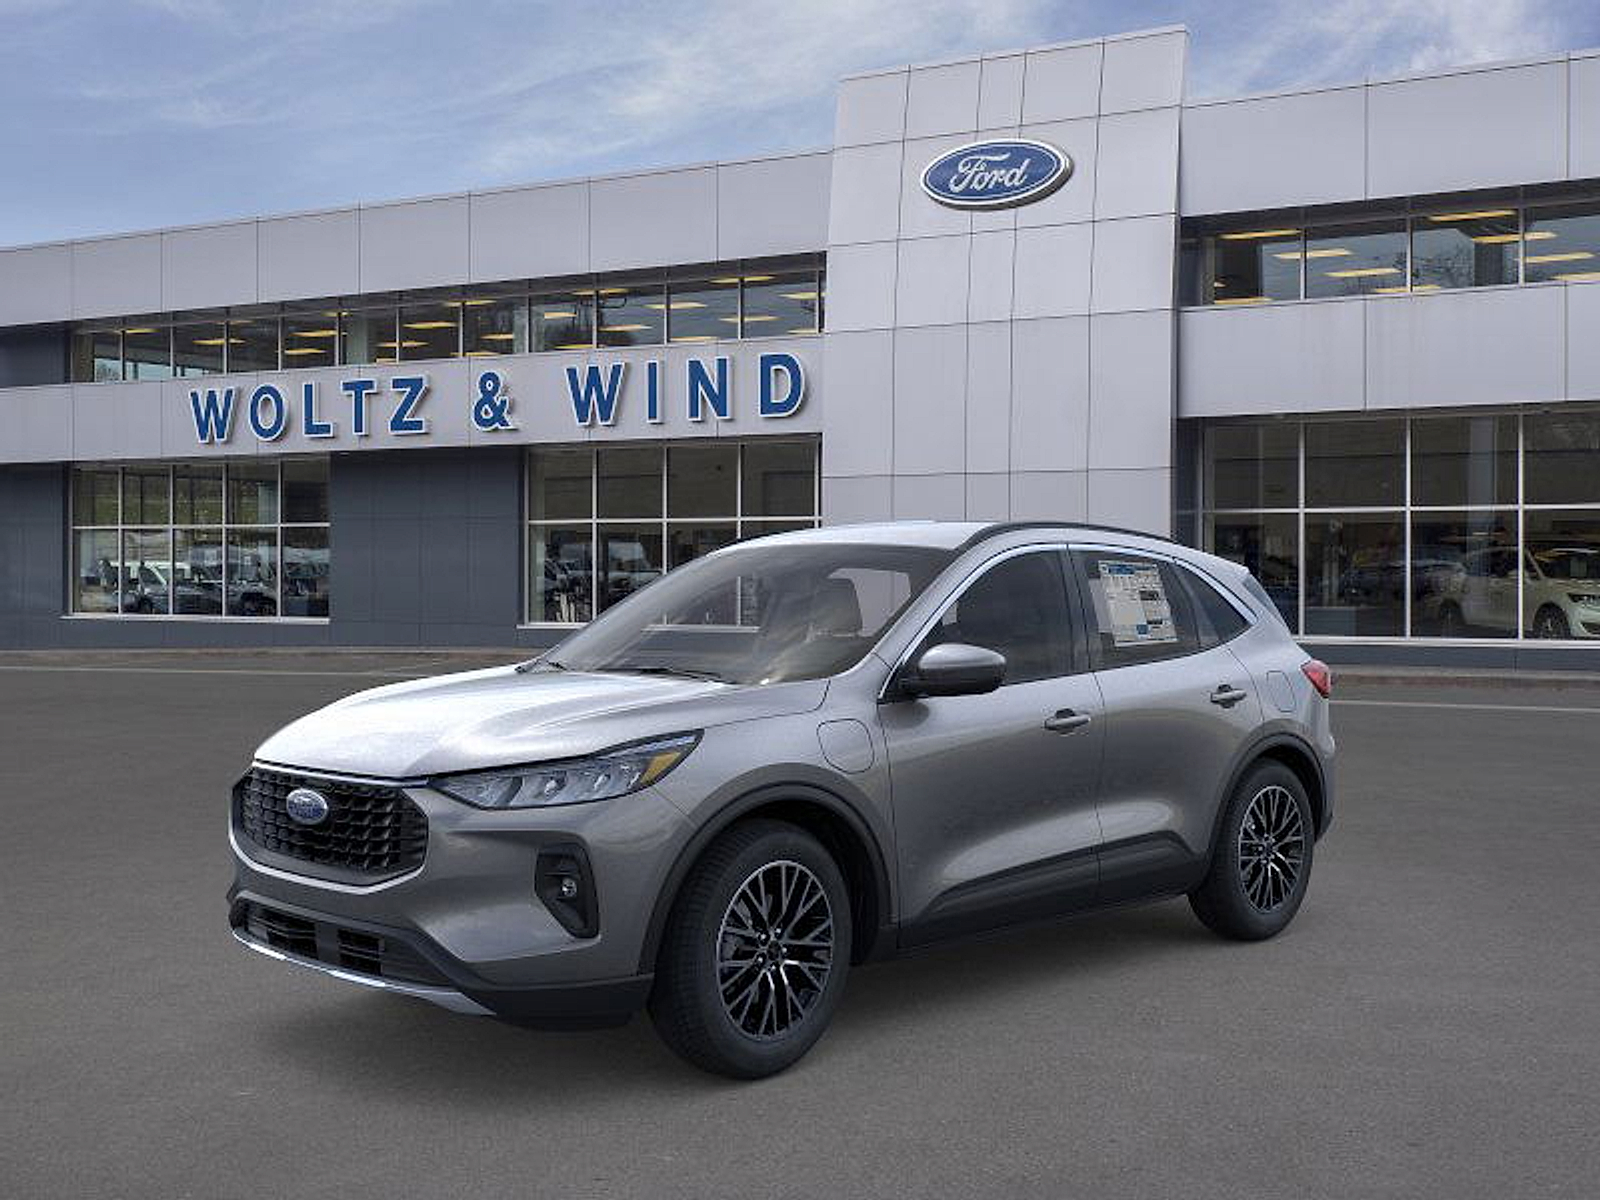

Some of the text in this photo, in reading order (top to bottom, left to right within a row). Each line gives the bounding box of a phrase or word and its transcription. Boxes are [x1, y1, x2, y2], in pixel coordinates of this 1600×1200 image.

[949, 152, 1031, 193] Ford
[190, 353, 806, 443] WOLTZ & WIND
